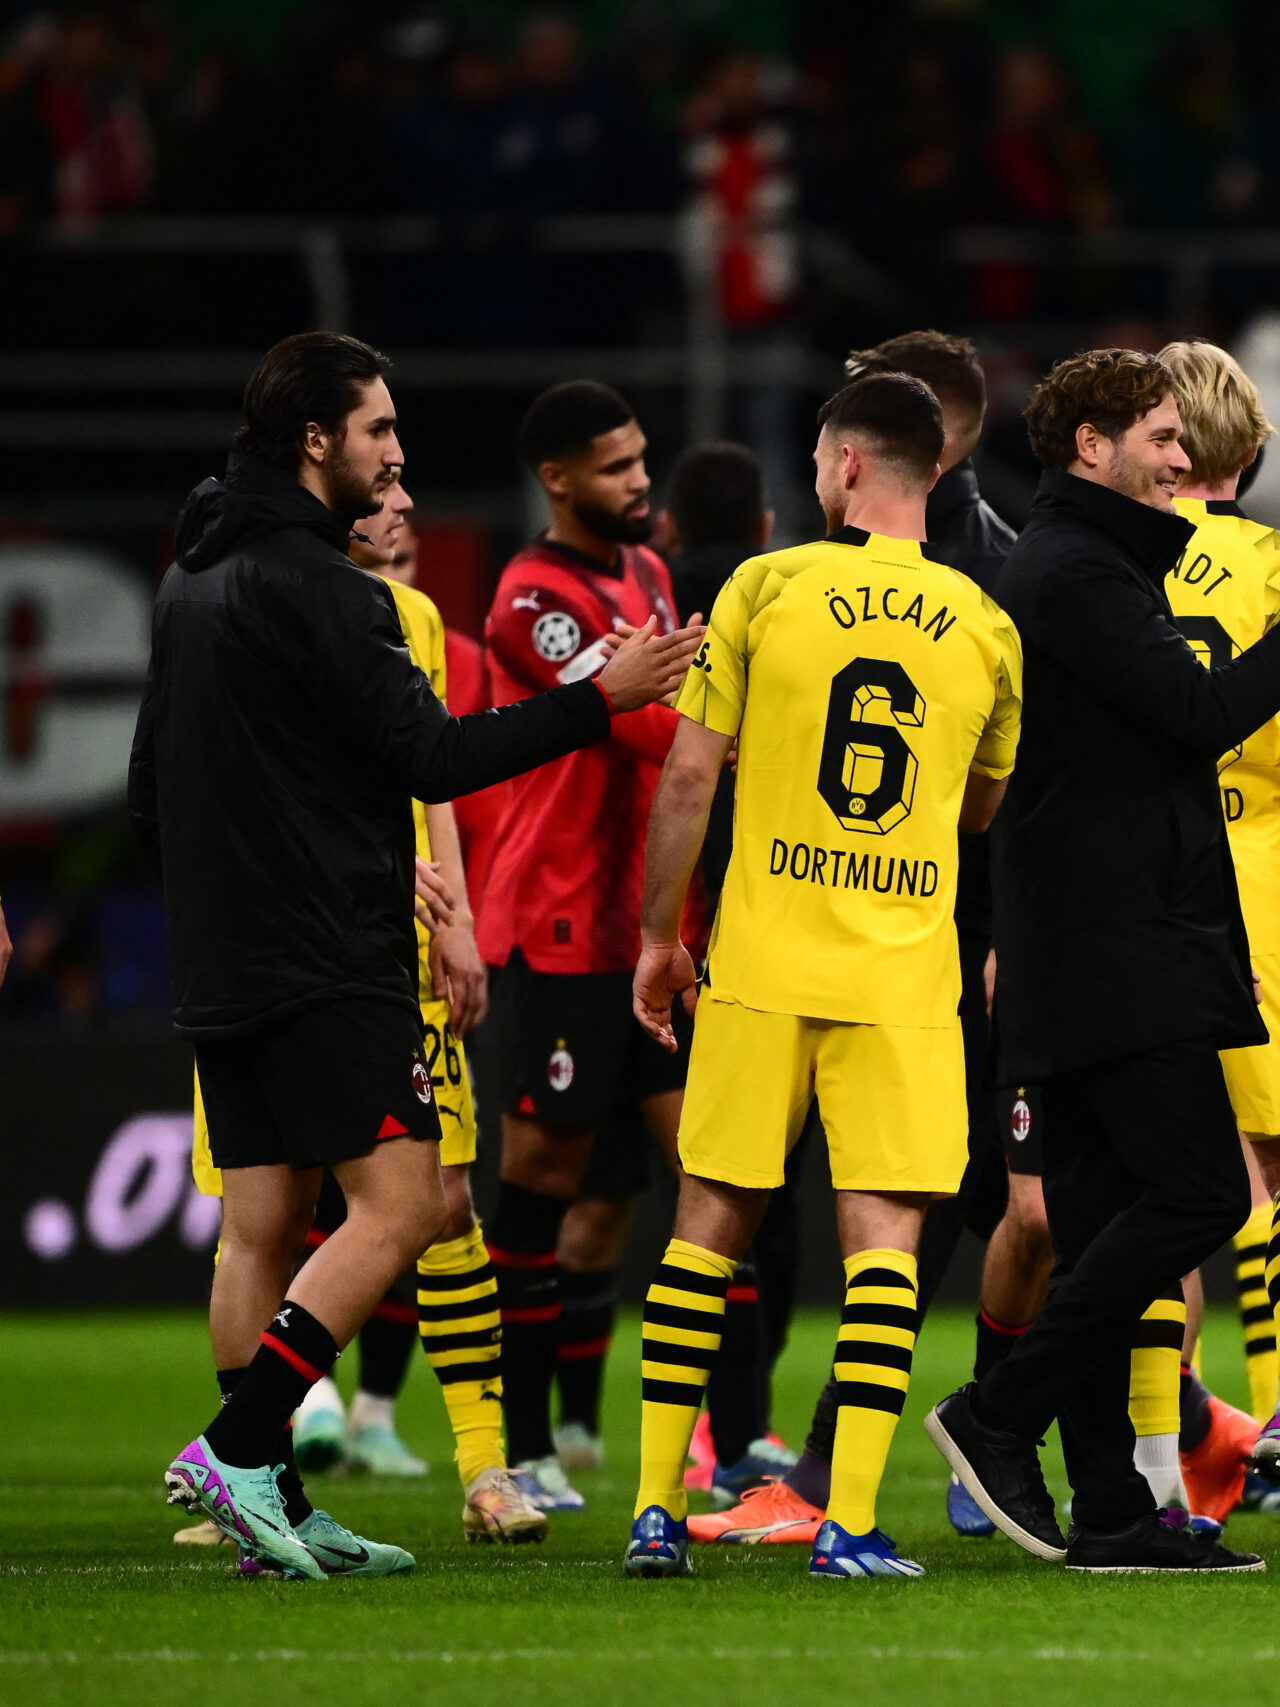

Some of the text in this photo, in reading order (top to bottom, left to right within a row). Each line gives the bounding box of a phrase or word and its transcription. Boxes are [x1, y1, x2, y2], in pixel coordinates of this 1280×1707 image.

[824, 586, 957, 643] ÖZCAN
[817, 656, 926, 835] 6
[770, 838, 939, 898] DORTMUND
[422, 1023, 463, 1092] 26
